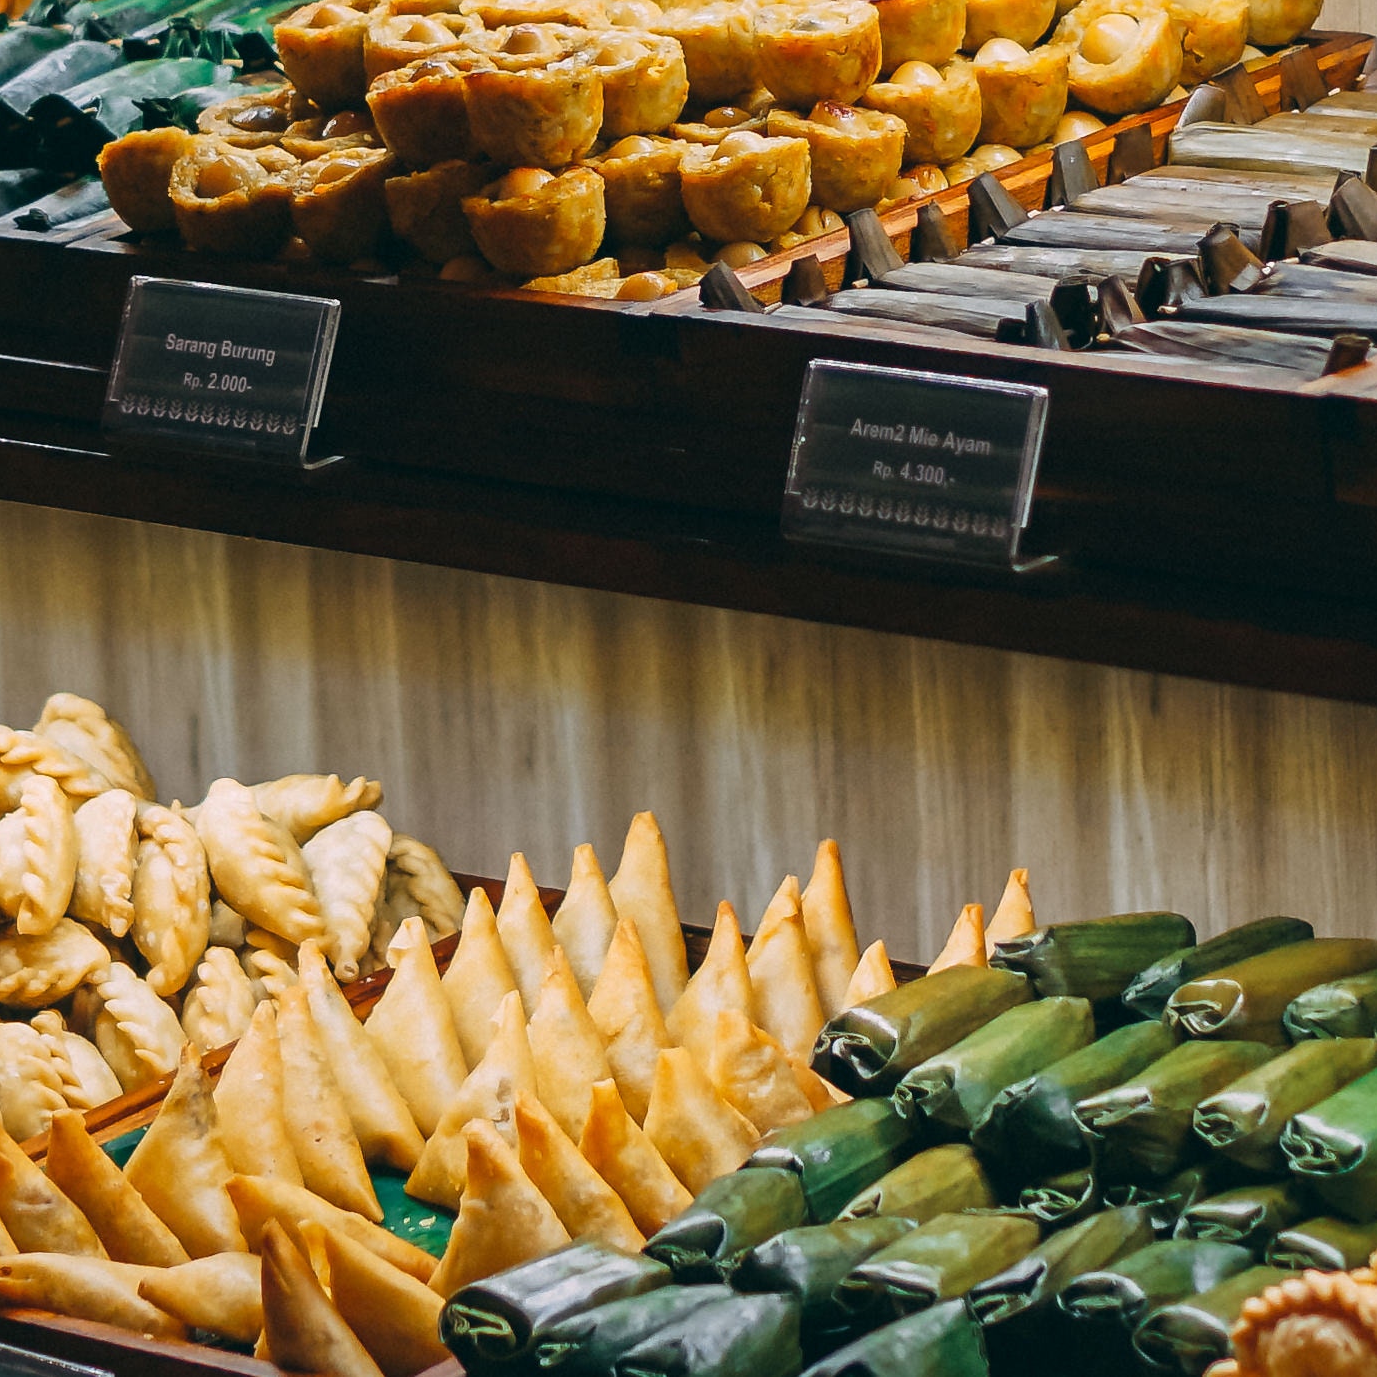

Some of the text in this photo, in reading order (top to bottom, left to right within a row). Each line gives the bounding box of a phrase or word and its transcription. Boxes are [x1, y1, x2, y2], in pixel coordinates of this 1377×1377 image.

[164, 332, 276, 367] Sarang Burung
[183, 371, 204, 390] Rp.
[849, 417, 991, 456] Arem2 Mie Ayam
[872, 460, 956, 489] Rp. 4.300,-
